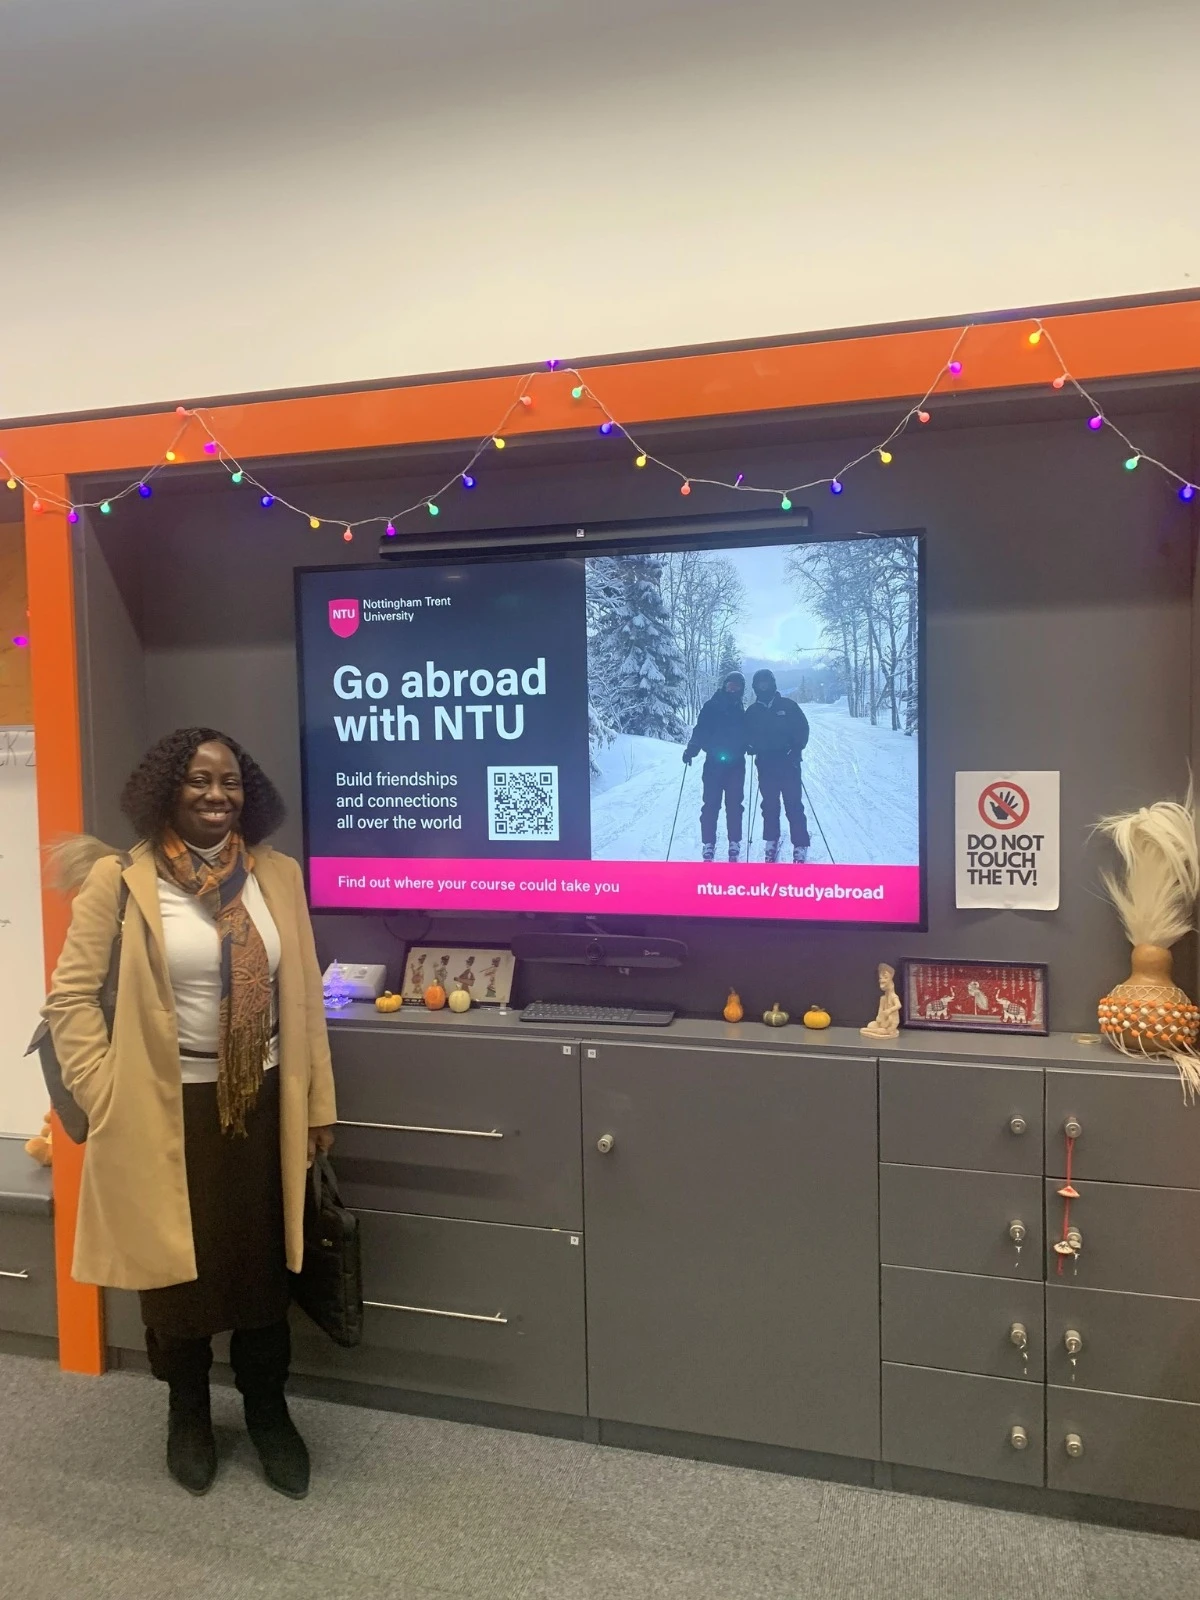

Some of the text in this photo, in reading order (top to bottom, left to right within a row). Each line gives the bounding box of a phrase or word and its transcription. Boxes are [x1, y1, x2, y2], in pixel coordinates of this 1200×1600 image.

[363, 596, 452, 610] Nottingham Trent
[332, 608, 356, 620] NTU
[363, 610, 415, 622] University
[333, 658, 547, 700] Go abroad
[333, 705, 525, 742] with NTU
[336, 771, 458, 789] Build friendships
[336, 792, 458, 808] and connections
[336, 814, 462, 830] all over the world
[968, 834, 1044, 851] DO NOT
[967, 852, 1035, 868] TOUCH
[338, 875, 620, 896] Find out where your course could take you
[967, 869, 1037, 886] THE TV!
[697, 882, 884, 902] ntu.ac.uk/studyabroad
